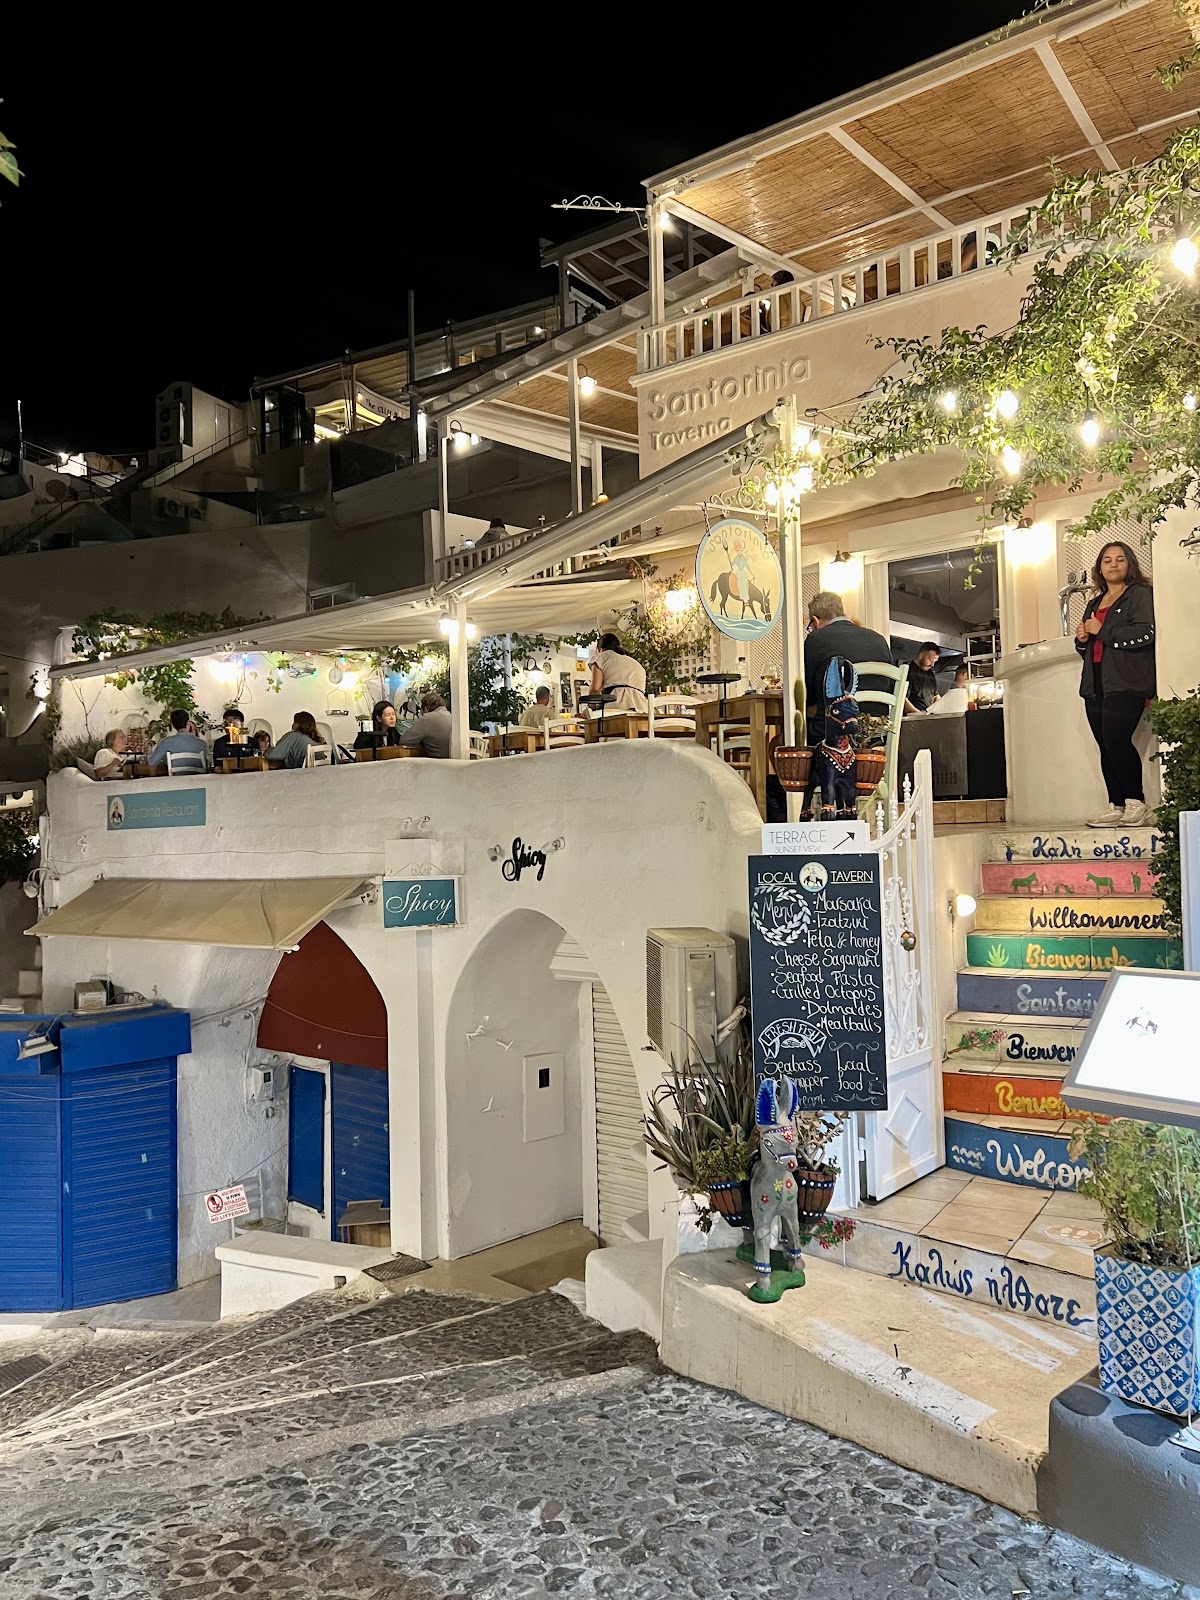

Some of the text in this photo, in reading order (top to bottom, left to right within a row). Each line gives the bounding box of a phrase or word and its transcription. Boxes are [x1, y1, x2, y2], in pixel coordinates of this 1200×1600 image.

[649, 355, 811, 421] Santorinia
[649, 416, 732, 450] Taverna
[769, 830, 827, 844] TERRACE
[502, 837, 547, 881] Spicy
[775, 845, 821, 854] SUNSET VIEW
[757, 870, 873, 884] LOCAL TAVERN
[386, 884, 452, 921] Spicy
[762, 895, 794, 927] Menu
[1029, 906, 1168, 931] Willkommen
[807, 929, 880, 955] Feta & honey
[775, 949, 820, 967] Cheese
[774, 966, 880, 988] Seafood Pasta
[776, 982, 876, 1006] Grilled Octopus
[803, 999, 882, 1019] Dolmades
[765, 1021, 821, 1041] FRESH FISH
[821, 1015, 882, 1036] Meatballs
[1006, 1033, 1079, 1062] Bienven
[764, 1054, 821, 1075] Seabass
[837, 1071, 863, 1091] food
[220, 1208, 248, 1220] LITTERING
